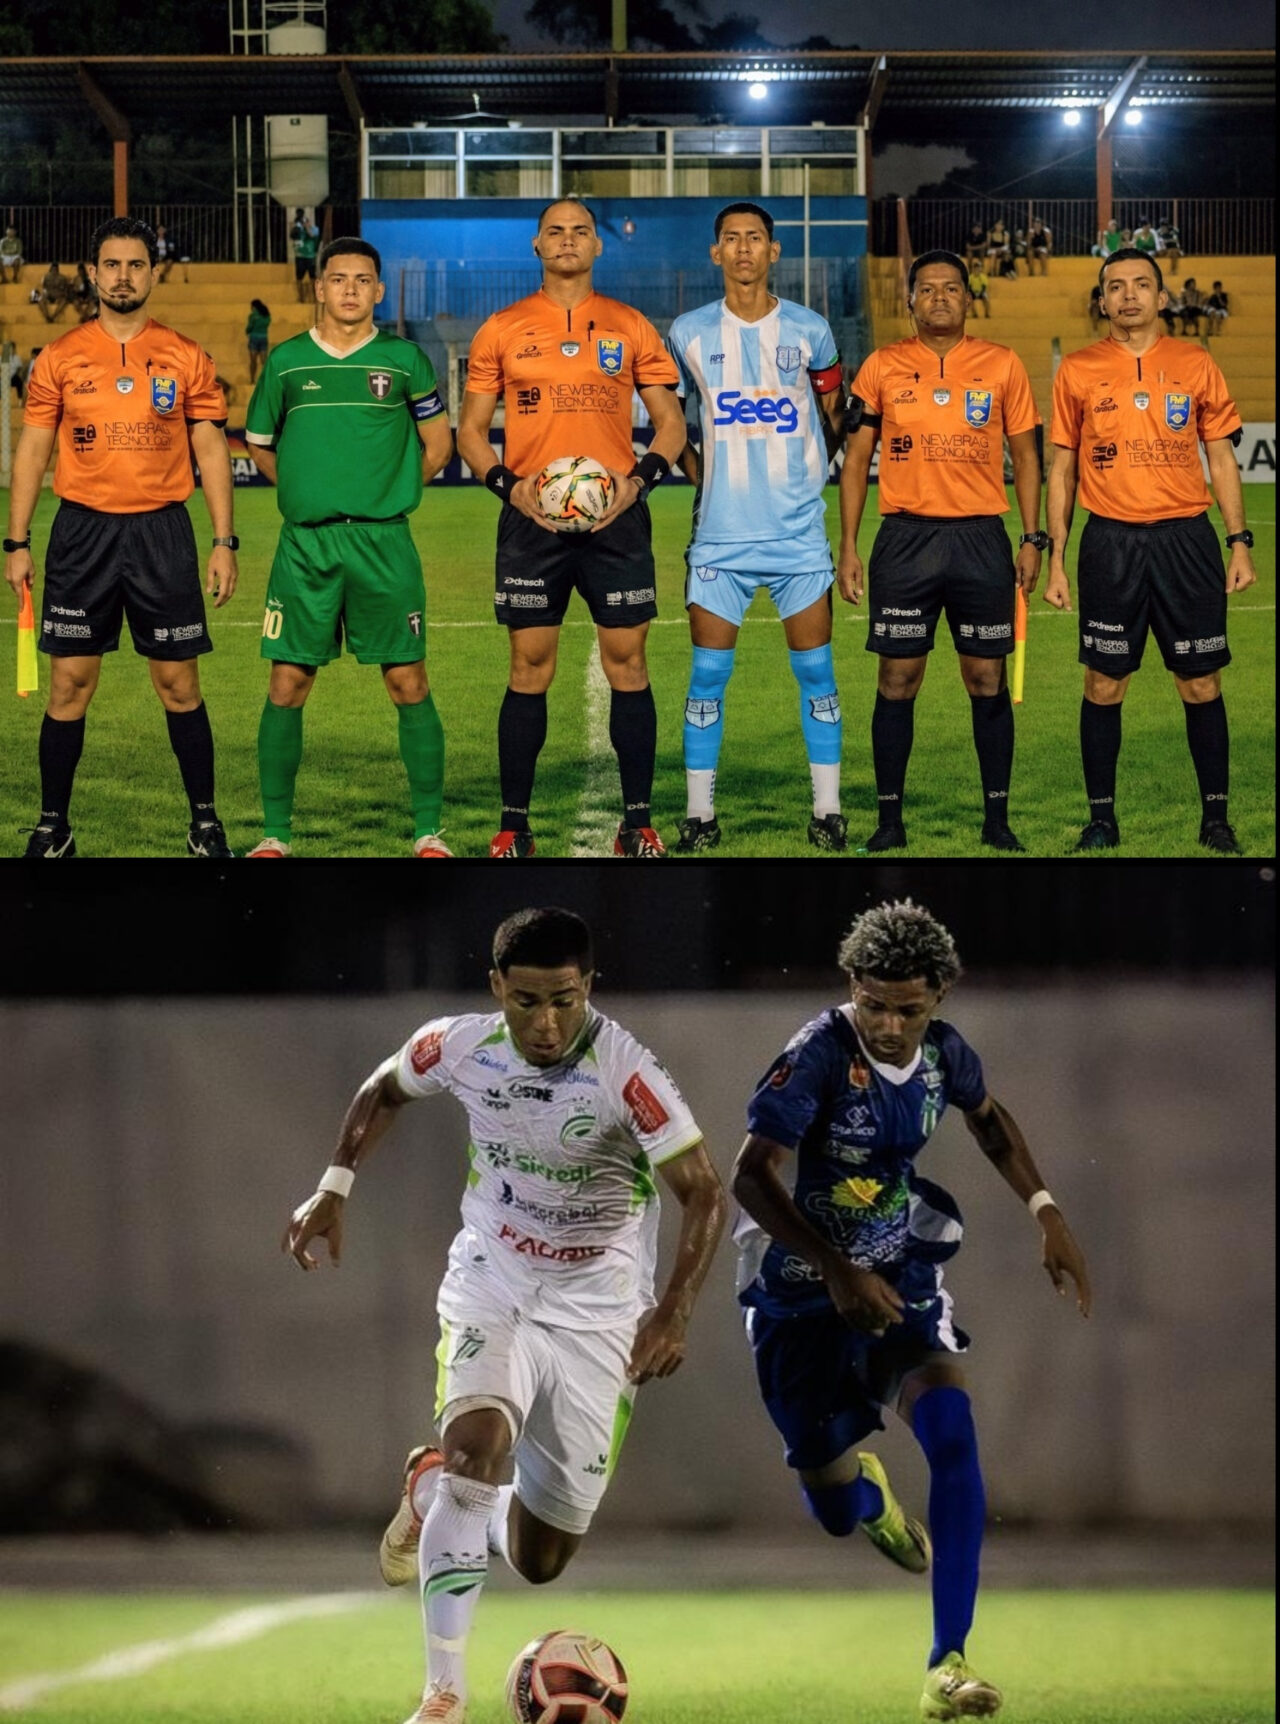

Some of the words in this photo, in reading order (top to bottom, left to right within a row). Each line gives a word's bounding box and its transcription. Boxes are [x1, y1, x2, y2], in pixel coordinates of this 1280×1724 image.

[549, 384, 618, 398] NEWBRAG
[714, 390, 799, 434] Seeg
[105, 422, 171, 435] NEWBRAG
[920, 434, 989, 448] NEWBRAG
[1125, 439, 1189, 452] NEWBRAG
[514, 577, 544, 587] dresch
[57, 608, 85, 617] dresch
[892, 608, 921, 617] dresch
[1097, 621, 1124, 632] dresch
